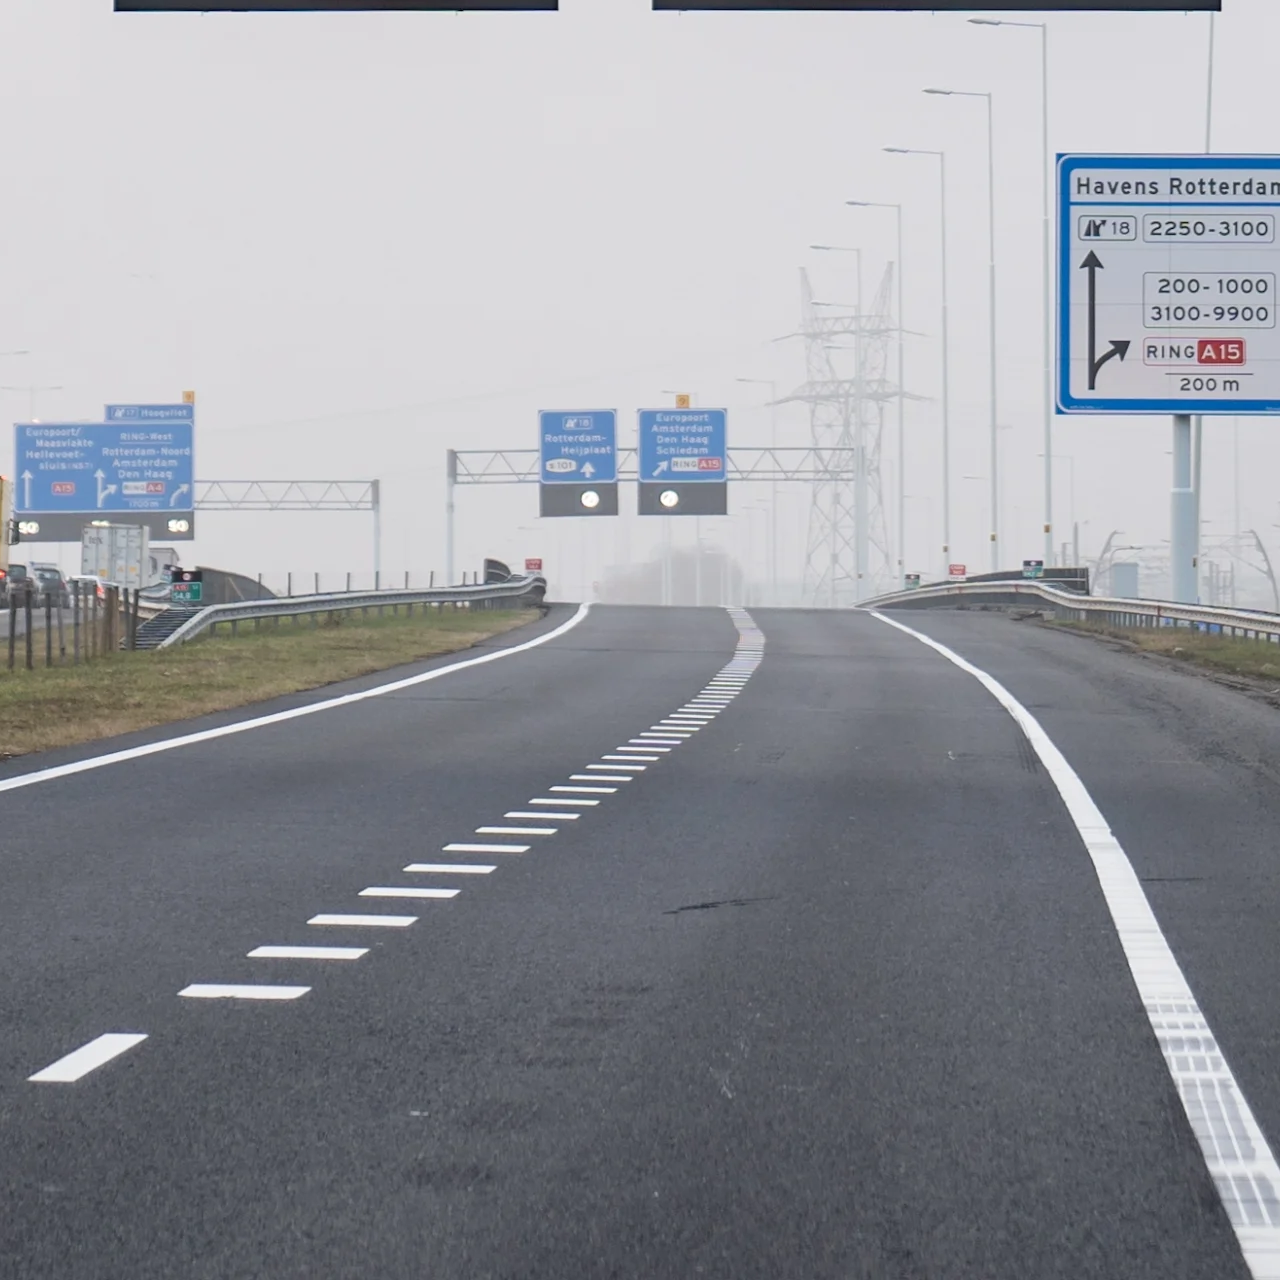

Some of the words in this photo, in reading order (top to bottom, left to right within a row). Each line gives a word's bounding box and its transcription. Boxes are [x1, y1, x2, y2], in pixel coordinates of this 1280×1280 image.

[1077, 177, 1159, 195] Havens
[1111, 221, 1131, 235] 18
[1150, 221, 1268, 236] 2250-3100
[1150, 306, 1268, 321] 3100-9900
[1146, 345, 1195, 359] RING
[1201, 344, 1240, 360] A15
[1179, 378, 1217, 392] 200
[1223, 379, 1239, 391] m
[141, 409, 188, 418] Hoogvliet
[656, 413, 709, 422] Europoort
[580, 419, 590, 427] 18
[26, 427, 83, 437] Europoort/
[651, 424, 713, 432] Amsterdam
[120, 432, 173, 441] RING-West
[544, 434, 607, 442] Rotterdam-
[657, 435, 677, 444] Den
[681, 435, 708, 445] Haag
[36, 439, 94, 447] Maasvlakte
[26, 450, 85, 459] Hellevoet-
[102, 447, 191, 456] Rotterdam-Noord
[561, 446, 611, 456] Heijplaat
[656, 446, 709, 455] Schiedam
[39, 462, 66, 470] sluis
[112, 459, 178, 467] Amsterdam
[557, 461, 572, 469] 101
[673, 461, 697, 469] RING
[700, 460, 720, 468] A15
[118, 470, 140, 478] Den
[144, 470, 173, 480] Haag
[54, 484, 72, 492] A15
